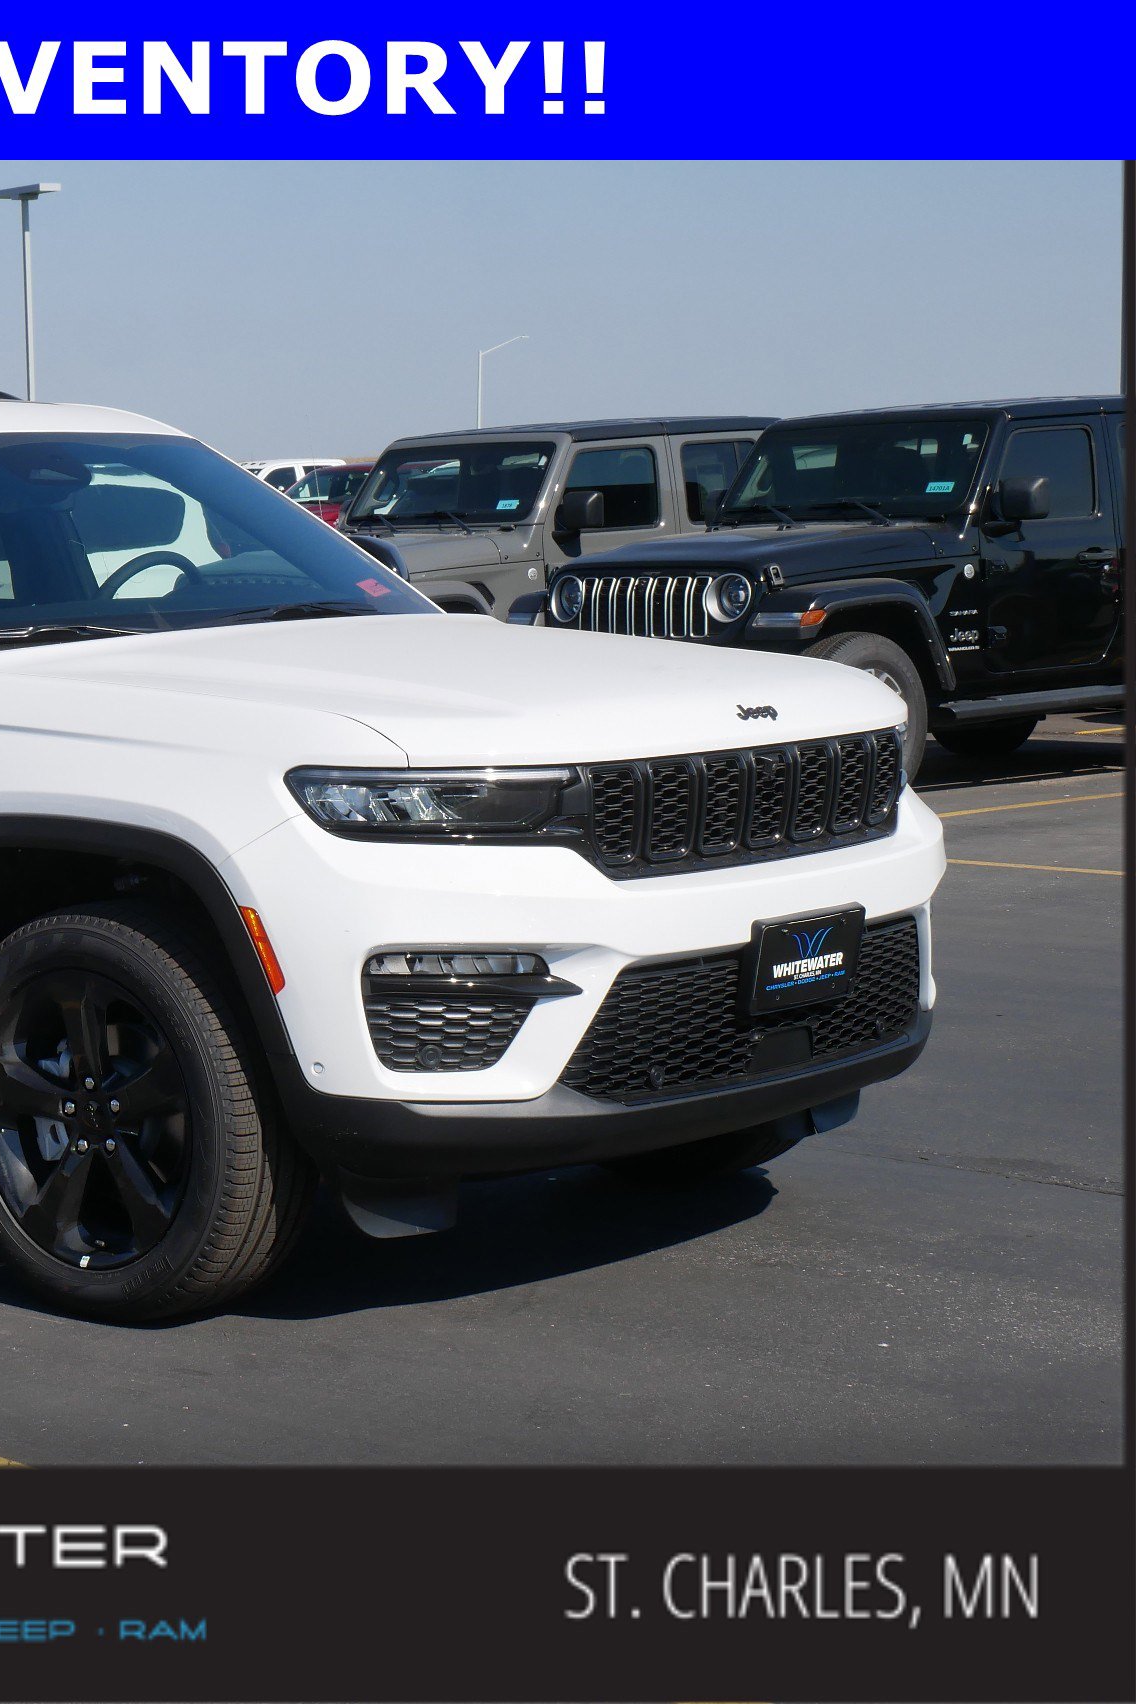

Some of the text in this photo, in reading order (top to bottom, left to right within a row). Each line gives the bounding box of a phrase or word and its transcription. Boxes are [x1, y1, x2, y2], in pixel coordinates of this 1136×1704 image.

[949, 627, 980, 644] Jeep
[736, 704, 778, 721] Jeep
[772, 951, 844, 979] WHITEWATER
[765, 980, 795, 991] CHRYSLER
